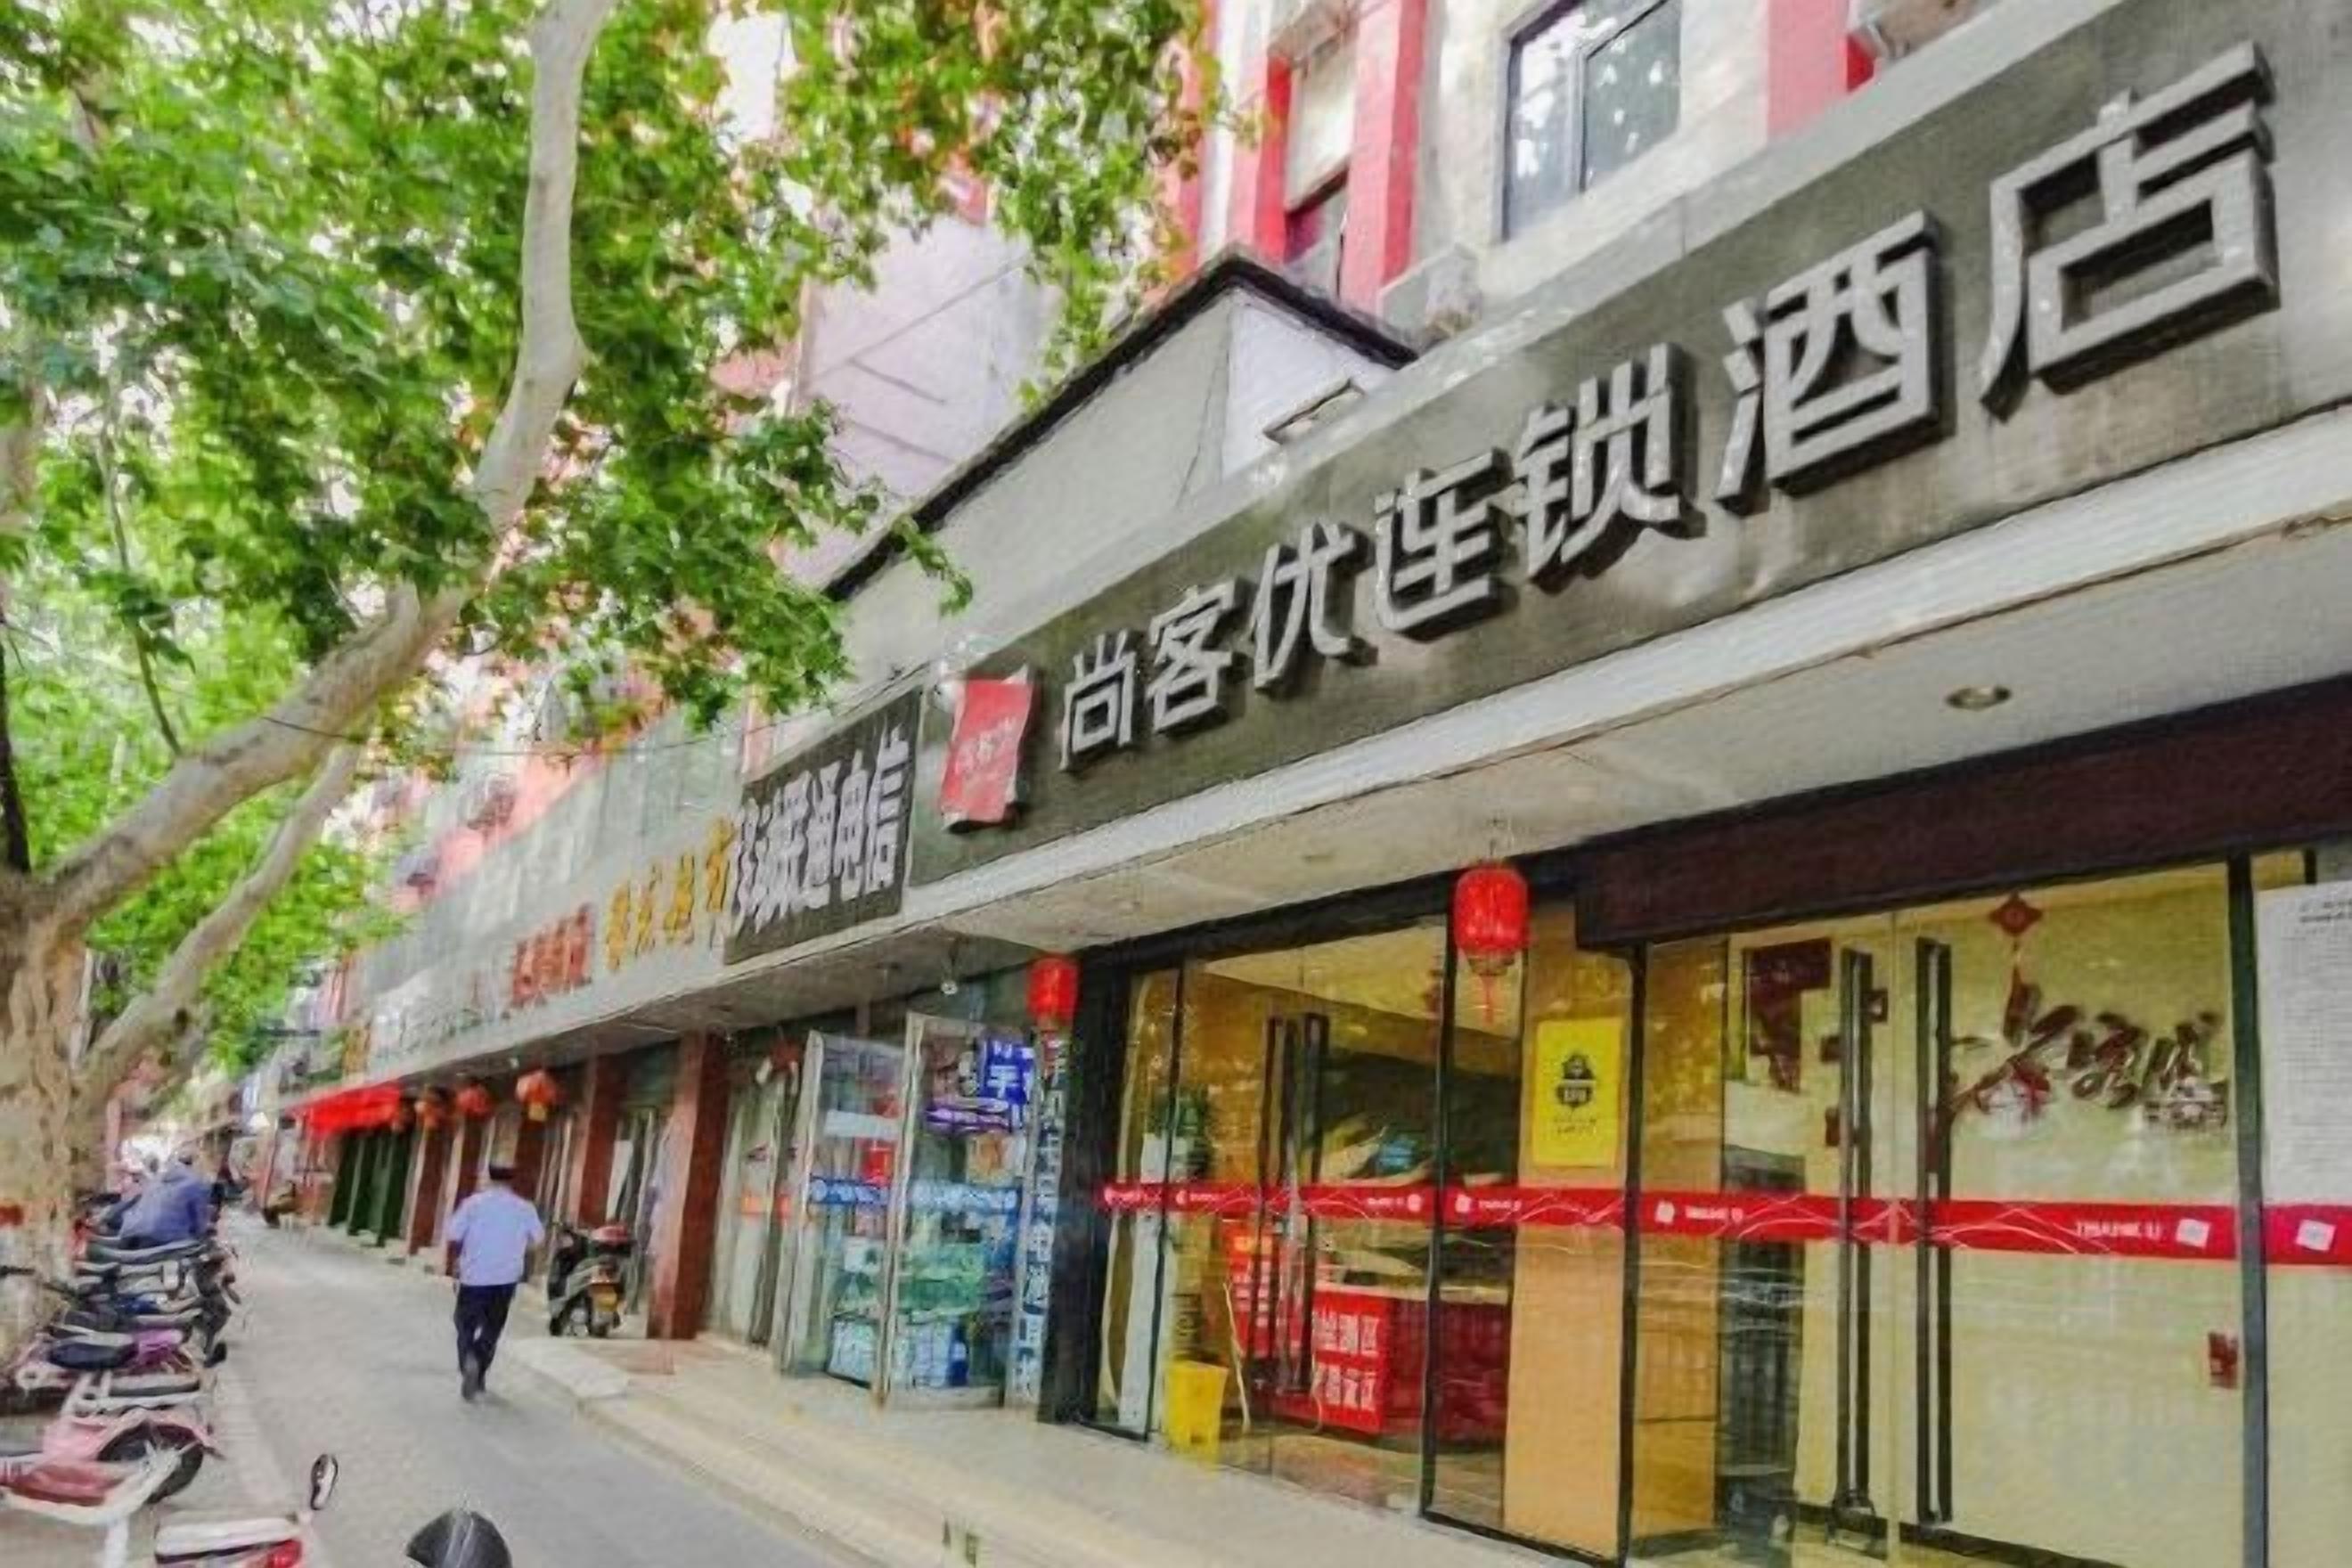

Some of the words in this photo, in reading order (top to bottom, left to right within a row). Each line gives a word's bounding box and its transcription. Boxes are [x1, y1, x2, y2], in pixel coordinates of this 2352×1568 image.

[1058, 41, 2274, 772] 尚客优连锁酒店
